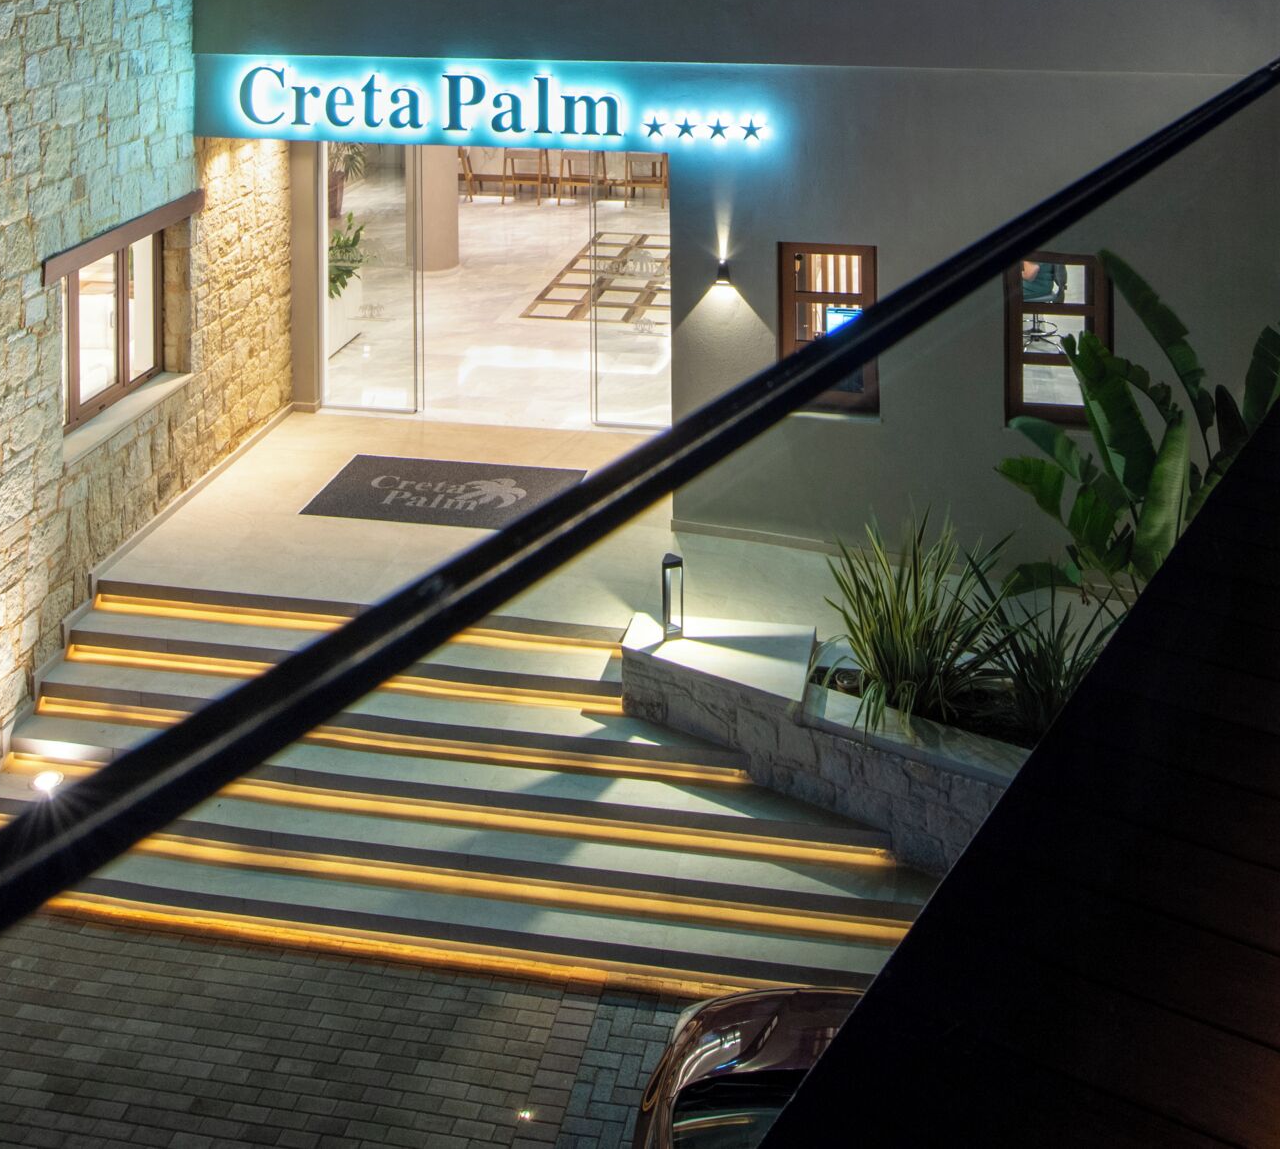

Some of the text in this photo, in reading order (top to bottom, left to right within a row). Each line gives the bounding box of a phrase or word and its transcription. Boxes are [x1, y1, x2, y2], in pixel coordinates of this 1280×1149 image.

[239, 66, 623, 137] Creta Palm
[371, 475, 466, 493] Creta
[381, 490, 478, 511] Palm
